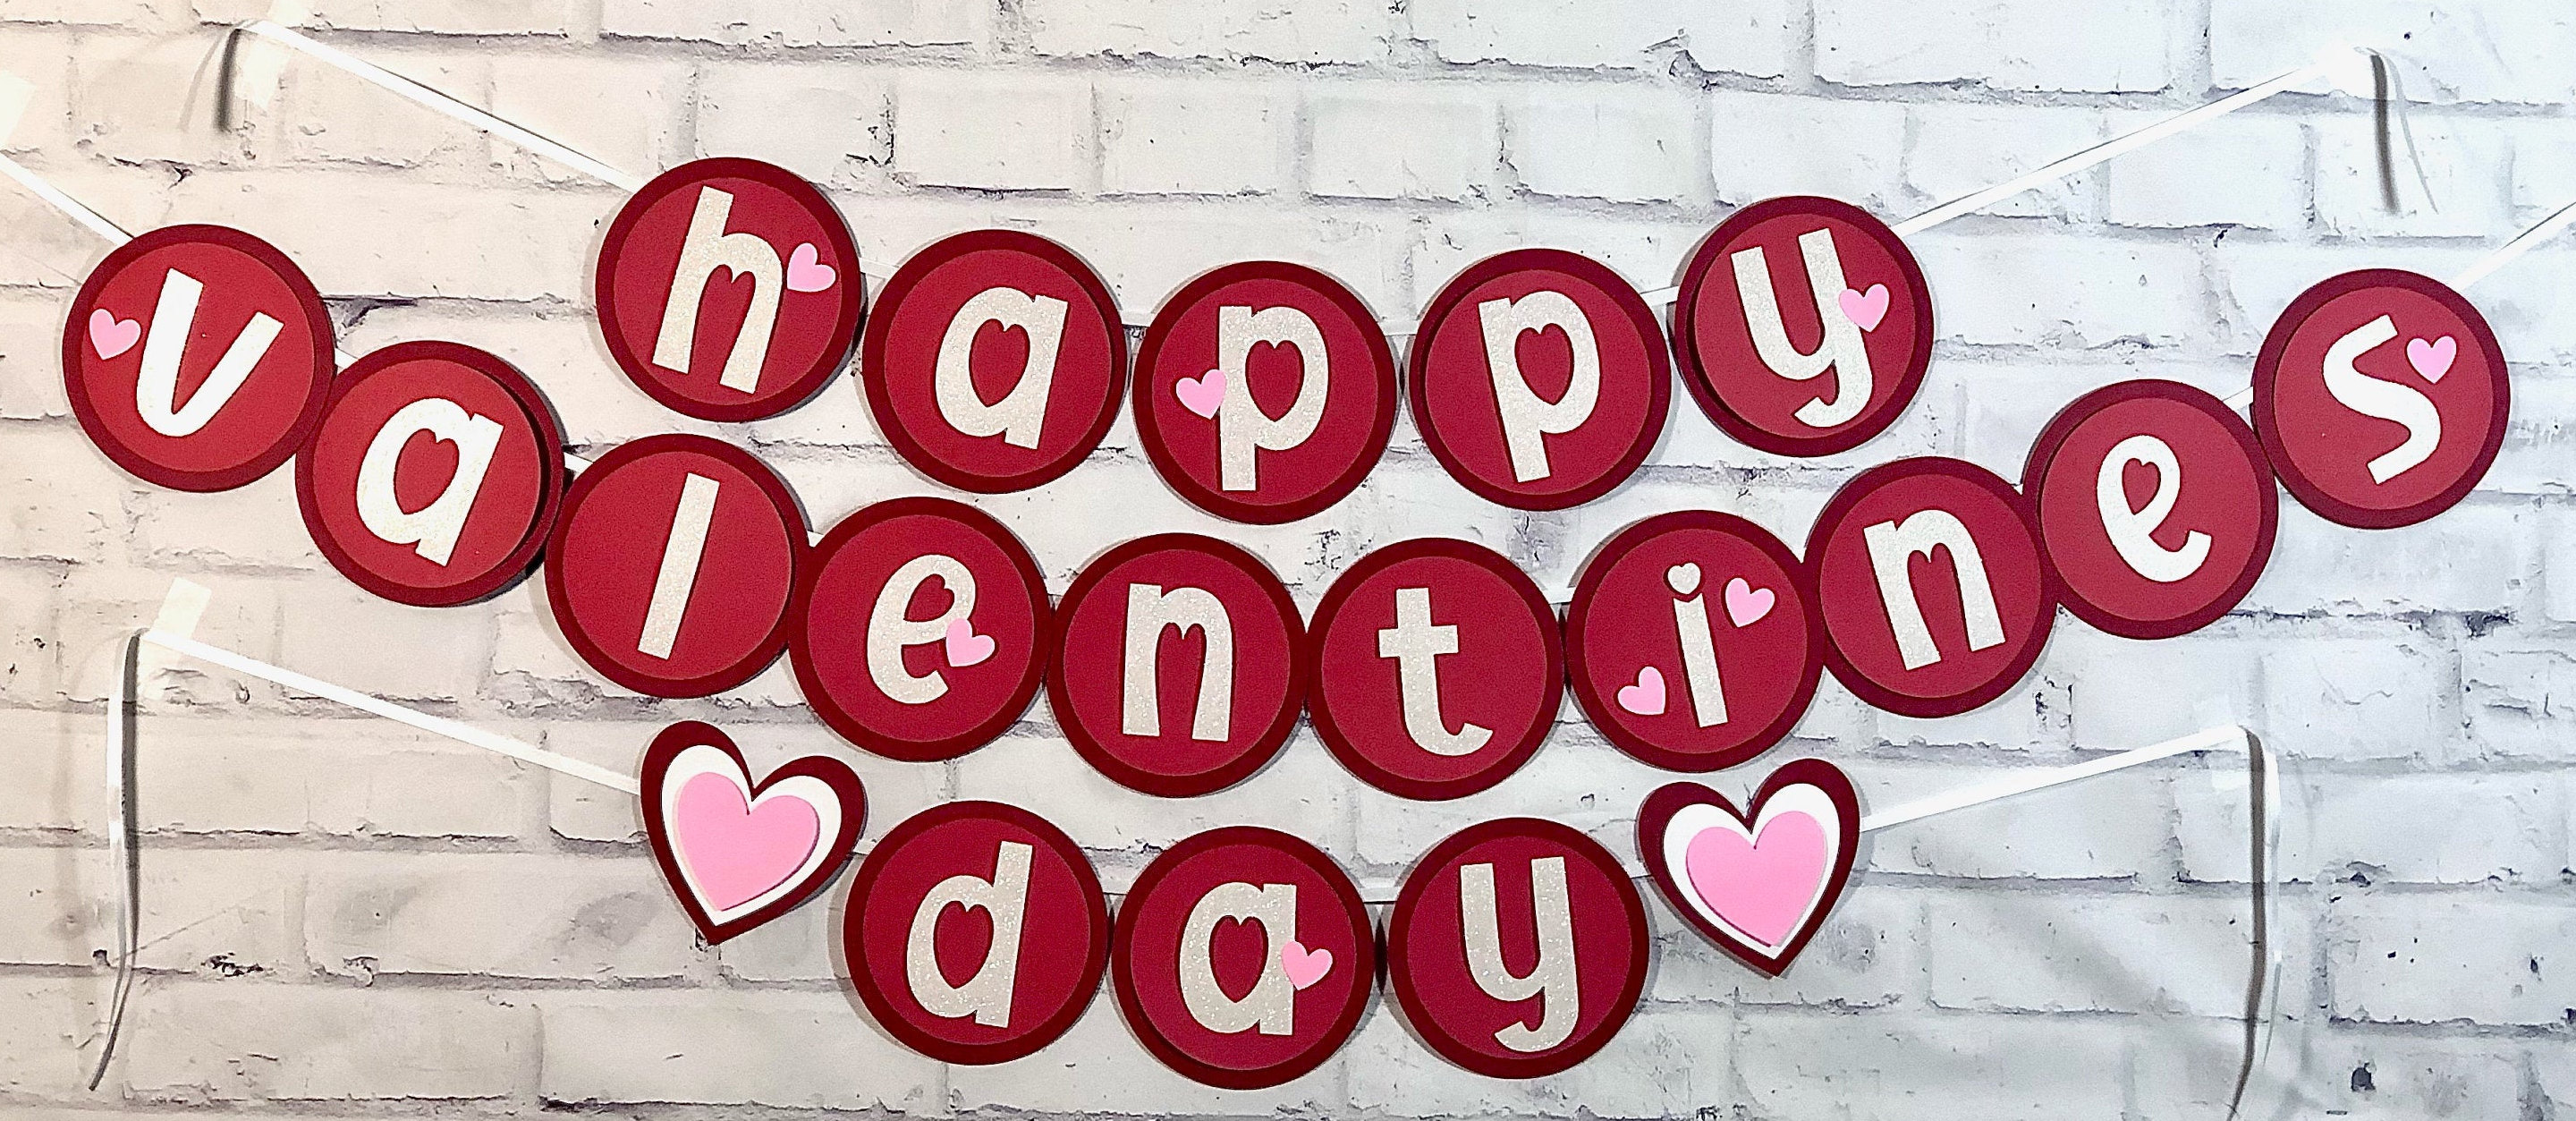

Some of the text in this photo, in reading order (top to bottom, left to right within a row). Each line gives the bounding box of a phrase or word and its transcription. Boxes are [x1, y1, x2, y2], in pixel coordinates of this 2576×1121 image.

[652, 186, 1875, 490] happy
[137, 268, 2441, 756] valentines
[907, 841, 1579, 1052] day
